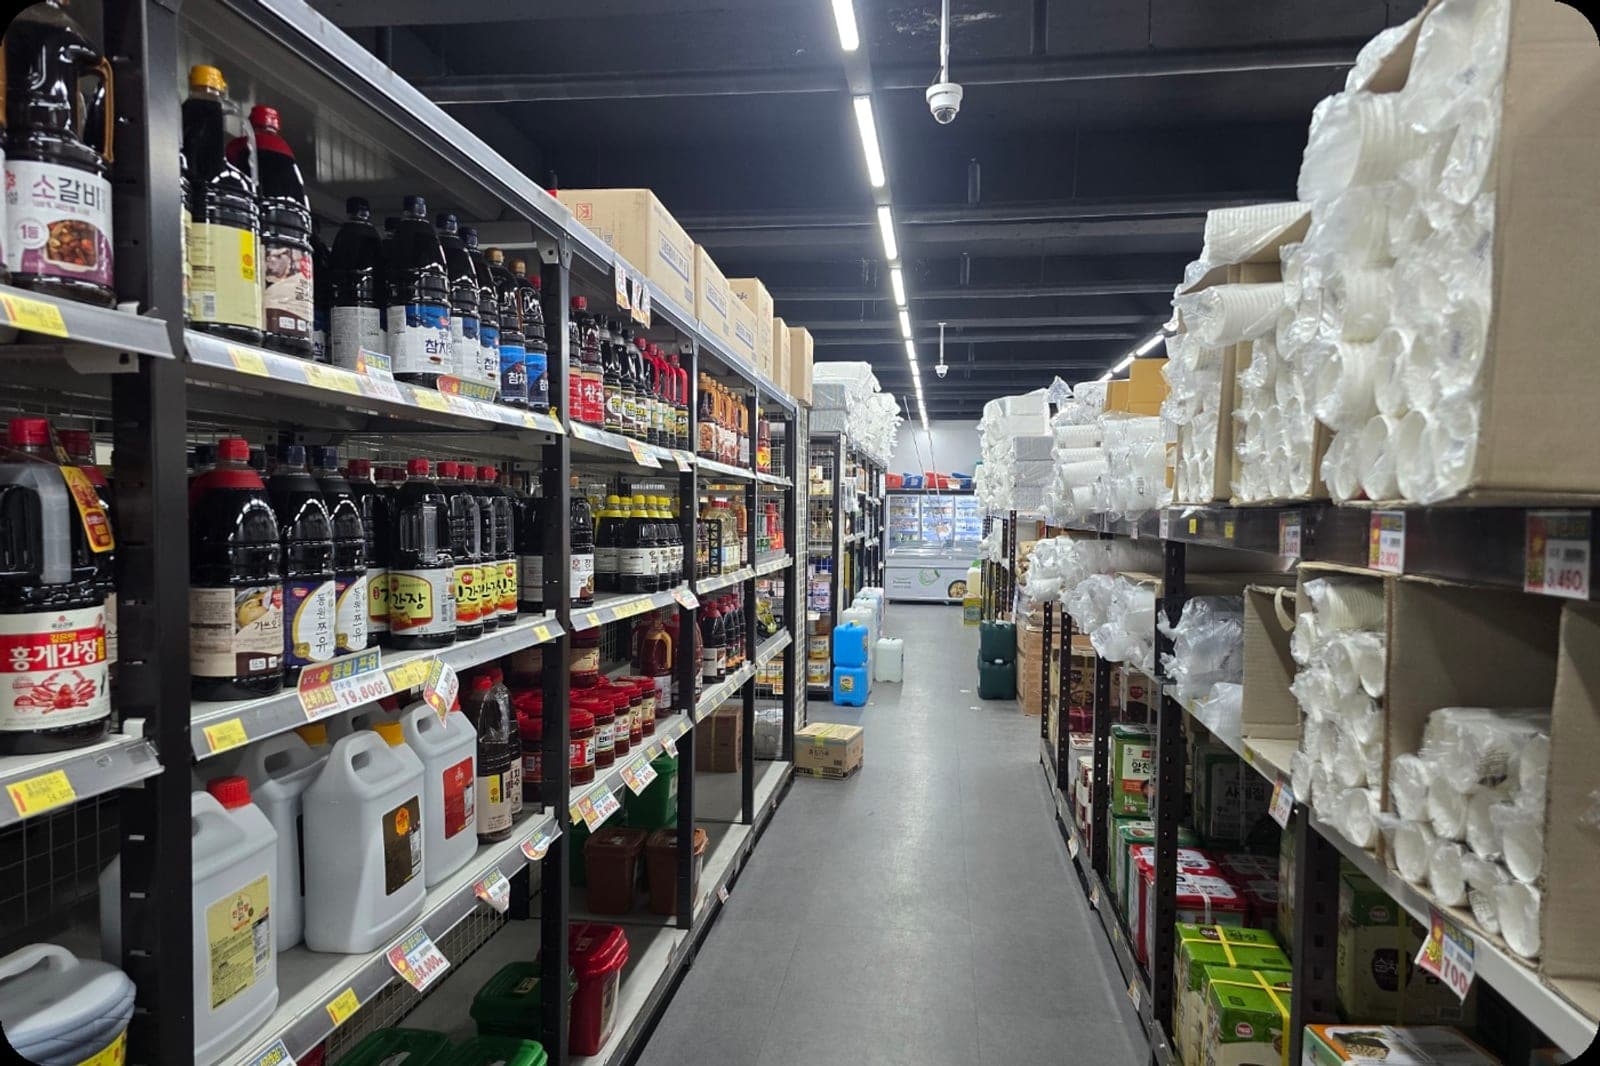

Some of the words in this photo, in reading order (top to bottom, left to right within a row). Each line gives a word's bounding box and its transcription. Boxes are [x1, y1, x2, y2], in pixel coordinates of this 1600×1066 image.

[392, 592, 427, 610] 간장
[8, 638, 97, 671] 홍게간장
[1444, 956, 1468, 994] 700
